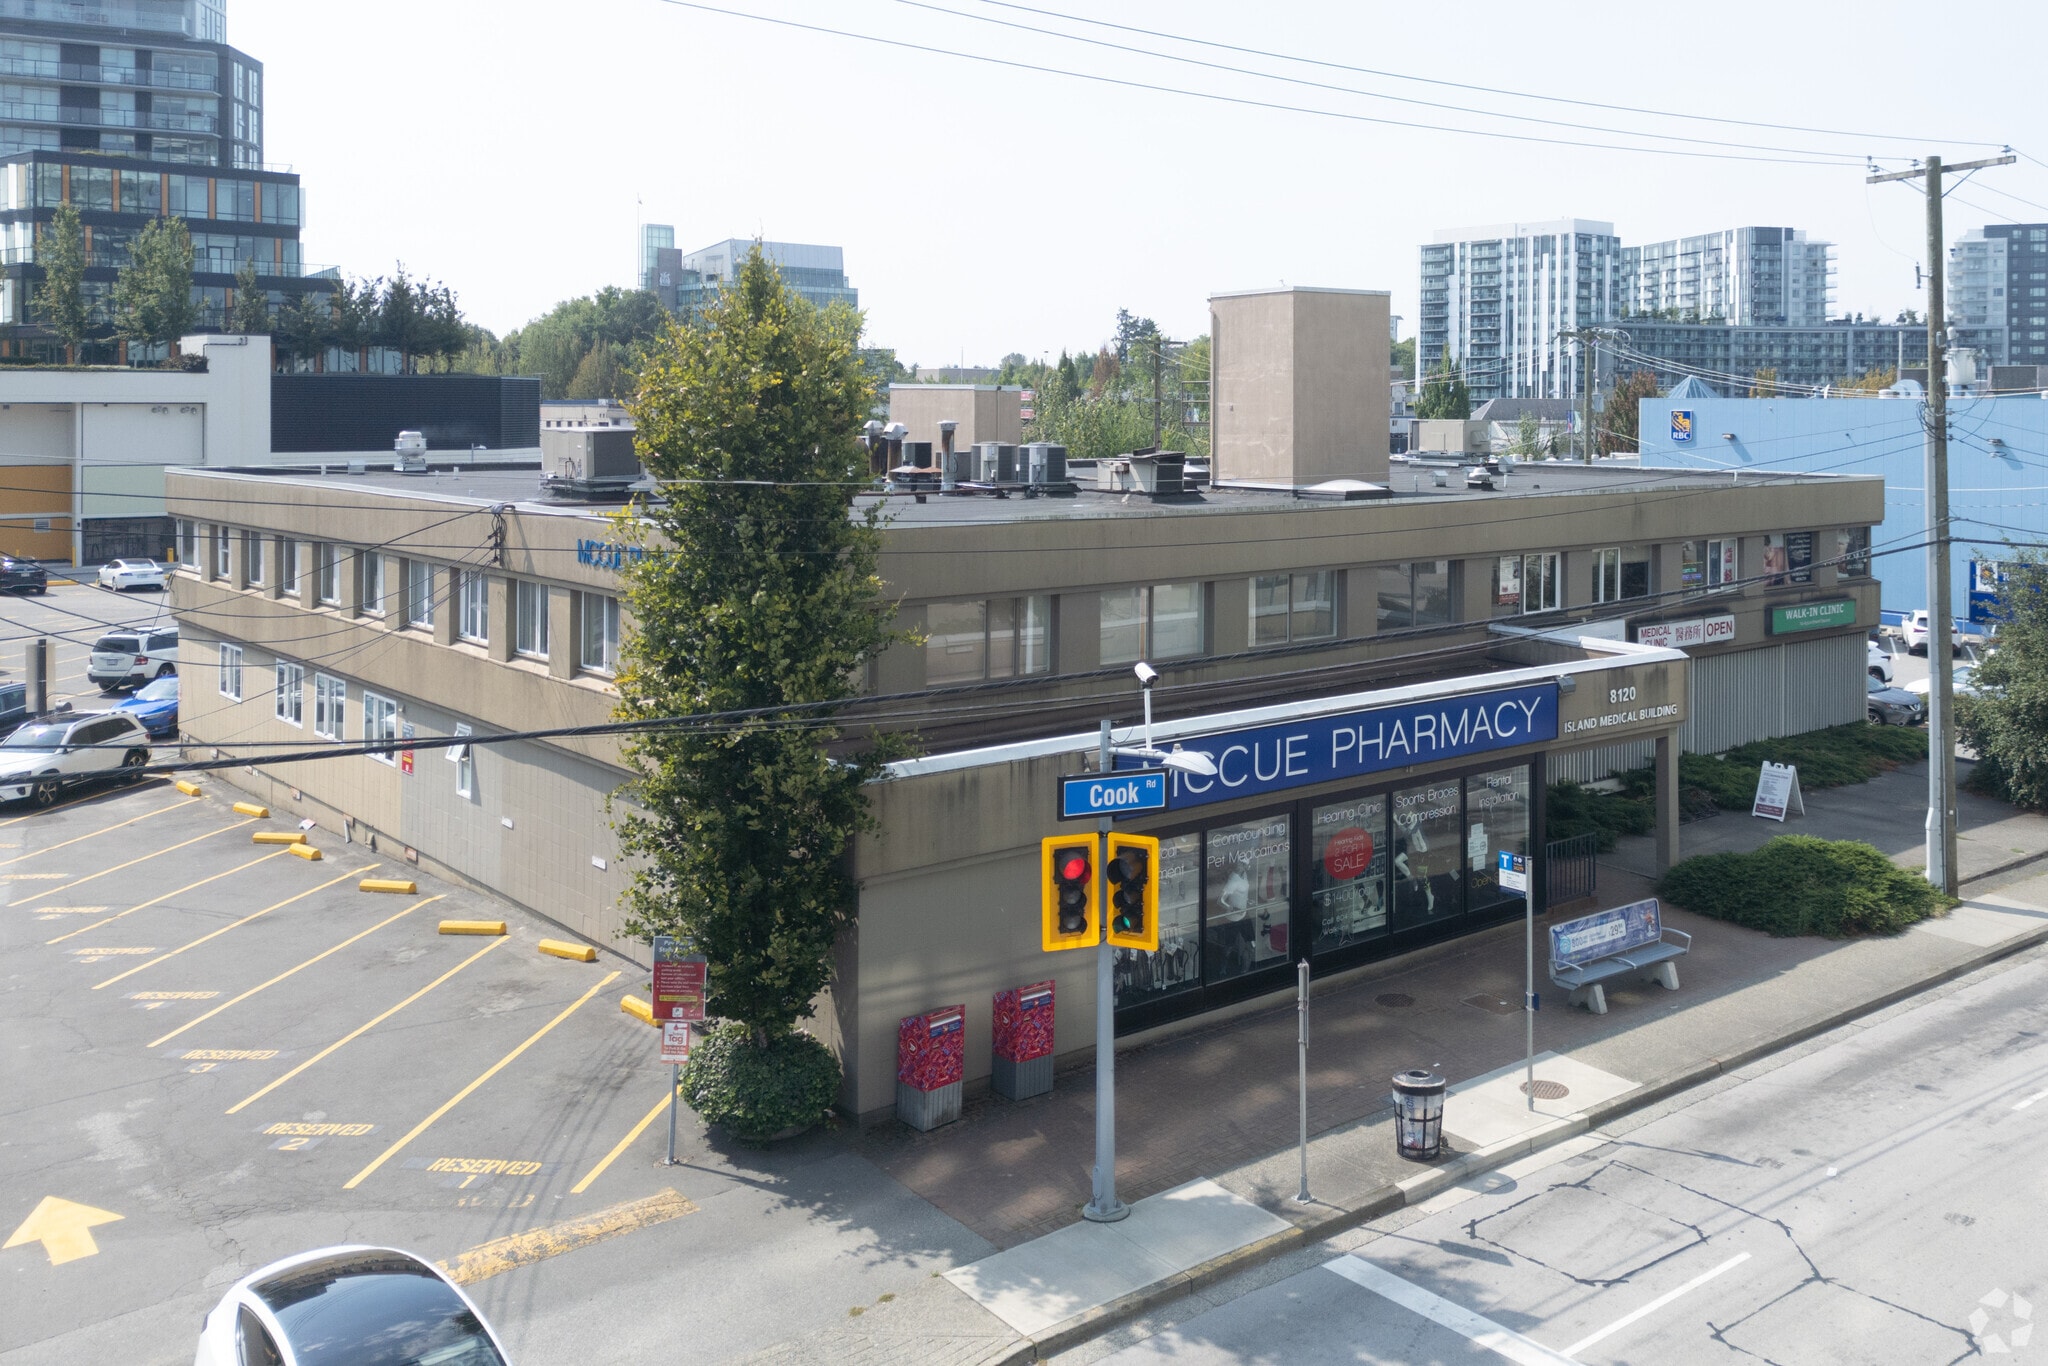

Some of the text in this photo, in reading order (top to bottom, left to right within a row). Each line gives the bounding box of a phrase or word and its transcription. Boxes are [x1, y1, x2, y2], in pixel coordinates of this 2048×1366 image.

[1672, 431, 1690, 440] RBC
[1785, 603, 1844, 620] WALK-IN CLINIC
[1640, 625, 1672, 639] MEDICAL
[1706, 620, 1733, 637] OPEN
[1609, 686, 1636, 704] 8120
[1564, 703, 1678, 733] ISLAND MEDICAL BUILDING
[1168, 696, 1542, 797] CCUE PHARMACY
[1089, 779, 1156, 808] Cook Rd
[1395, 786, 1459, 809] Sports Braces
[1317, 802, 1382, 825] Hearing Clinic
[1398, 804, 1457, 826] Compression
[1212, 822, 1286, 848] Compounding
[1207, 840, 1290, 869] Pet Medications
[1334, 853, 1365, 873] SALE
[1501, 854, 1509, 868] T
[130, 991, 221, 1000] RESERVED
[668, 1033, 684, 1045] Tag
[179, 1049, 280, 1060] RESERVED
[189, 1062, 218, 1073] 3
[262, 1122, 376, 1136] RESERVED
[278, 1137, 310, 1151] 2
[426, 1157, 543, 1176] RESERVED
[458, 1174, 477, 1189] 1
